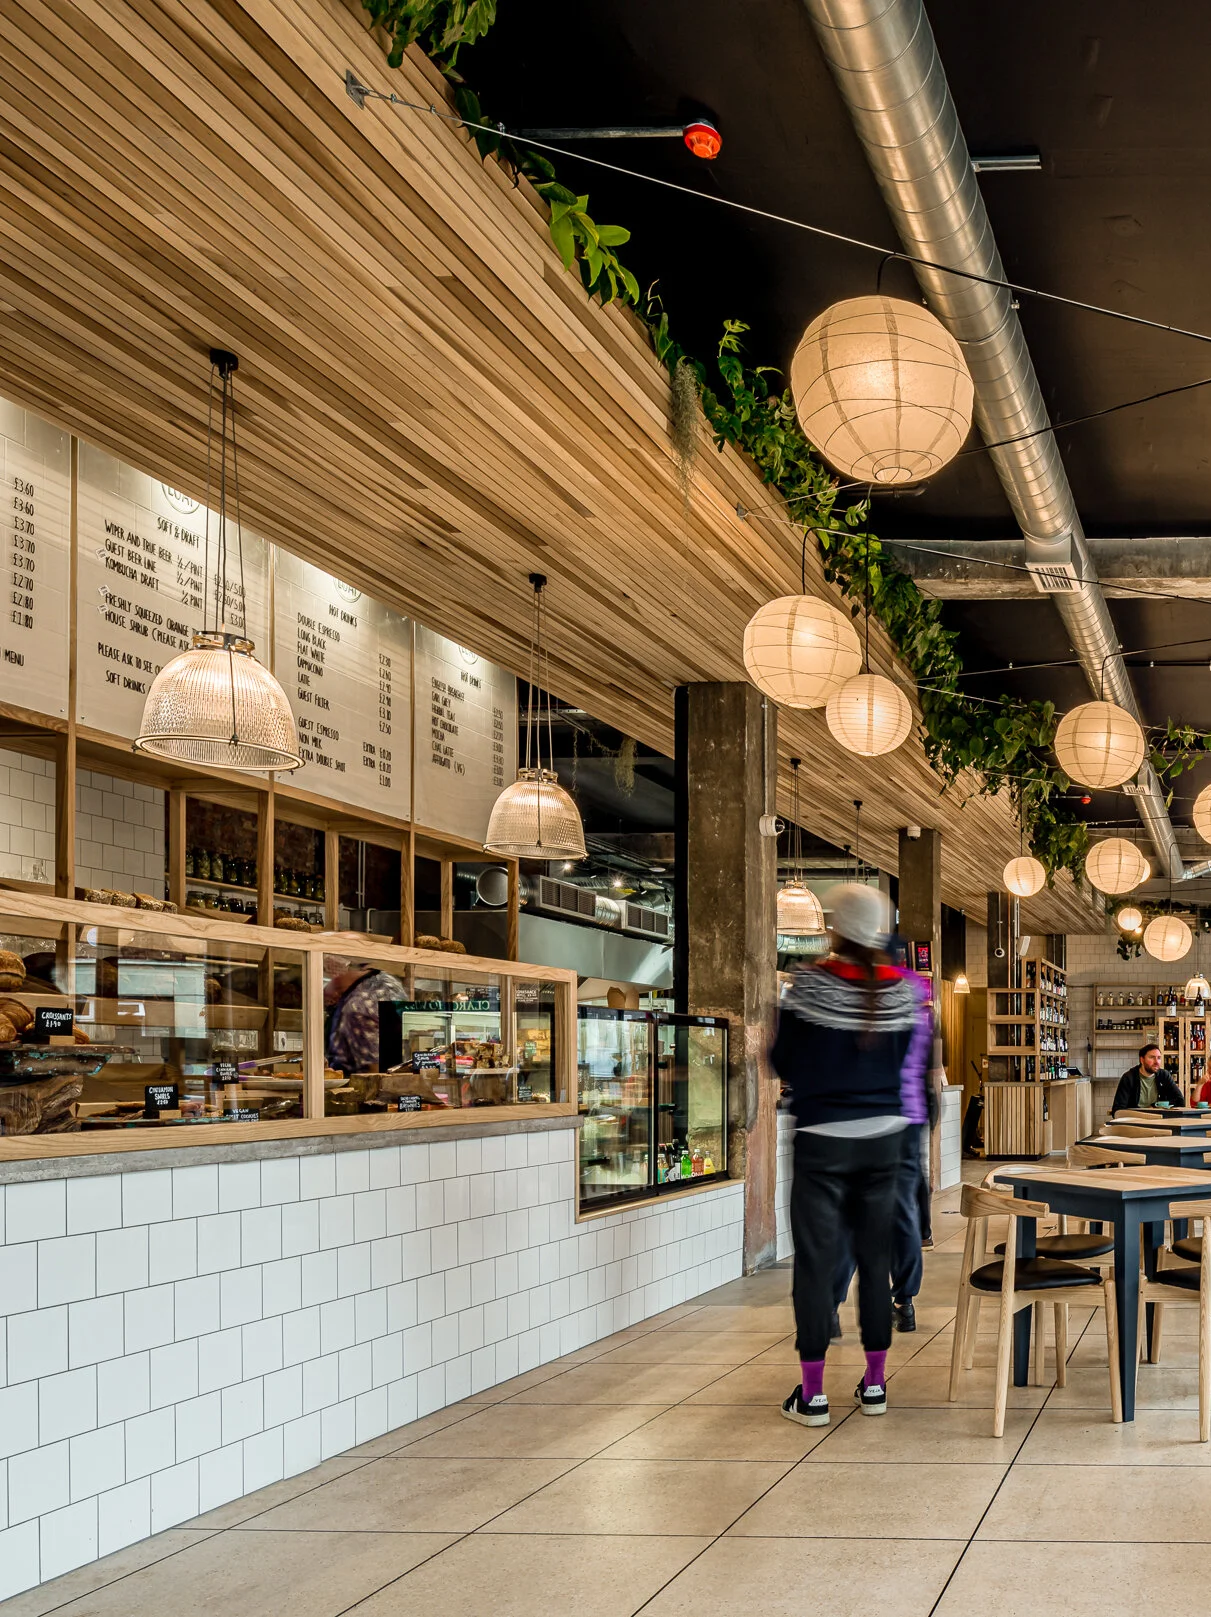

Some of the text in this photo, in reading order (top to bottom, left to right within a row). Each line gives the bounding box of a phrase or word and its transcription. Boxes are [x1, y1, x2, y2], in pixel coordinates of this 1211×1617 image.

[14, 477, 34, 498] £3.60
[13, 497, 34, 517] £3.60
[14, 516, 35, 536] £3.70
[157, 516, 200, 549] SOFT & DRAFT
[14, 535, 35, 554] £3.70
[104, 519, 125, 541] WIPER
[126, 531, 141, 548] AND
[142, 537, 157, 556] TRUE
[158, 546, 172, 564] BEER
[13, 553, 35, 573] £3.70
[105, 538, 125, 558] GUEST
[127, 549, 142, 567] BEER
[143, 557, 157, 574] LINE
[105, 556, 138, 581] KOMBUCHA
[140, 572, 159, 590] DRAFT
[190, 594, 203, 610] PINT
[12, 592, 34, 610] £2.80
[11, 611, 33, 629] £1.80
[105, 592, 132, 613] FRESHLY
[134, 604, 163, 626] SQUEEZED
[166, 617, 189, 638] ORANGE
[328, 603, 358, 628] HOT DRINKS
[105, 610, 126, 629] HOUSE
[129, 619, 149, 637] SHRUB
[152, 627, 177, 648] (PLEASE
[178, 639, 190, 652] ASK
[297, 612, 316, 631] DOUBLE
[318, 622, 340, 642] ESPRESSO
[297, 627, 311, 643] LONG
[312, 634, 326, 650] BLACK
[4, 649, 24, 667] MENU
[97, 641, 120, 662] PLEASE
[121, 652, 133, 667] ASK
[135, 656, 142, 670] TO
[143, 658, 153, 674] SEE
[297, 641, 308, 655] FLAT
[310, 647, 325, 664] WHITE
[105, 670, 121, 686] SOFT
[123, 676, 146, 694] DRINKS
[297, 671, 311, 687] LATTE
[297, 686, 313, 703] GUEST
[314, 693, 330, 711] FILTER
[298, 716, 314, 731] GUEST
[316, 722, 340, 741] ESPRESSO
[362, 741, 376, 756] EXTRA
[298, 731, 310, 746] NON
[311, 735, 323, 750] MILK
[362, 755, 376, 769] EXTRA
[298, 746, 314, 761] EXTRA
[316, 752, 333, 769] DOUBLE
[41, 1011, 72, 1021] CROISSANTS
[148, 1086, 174, 1094] CINNAMON
